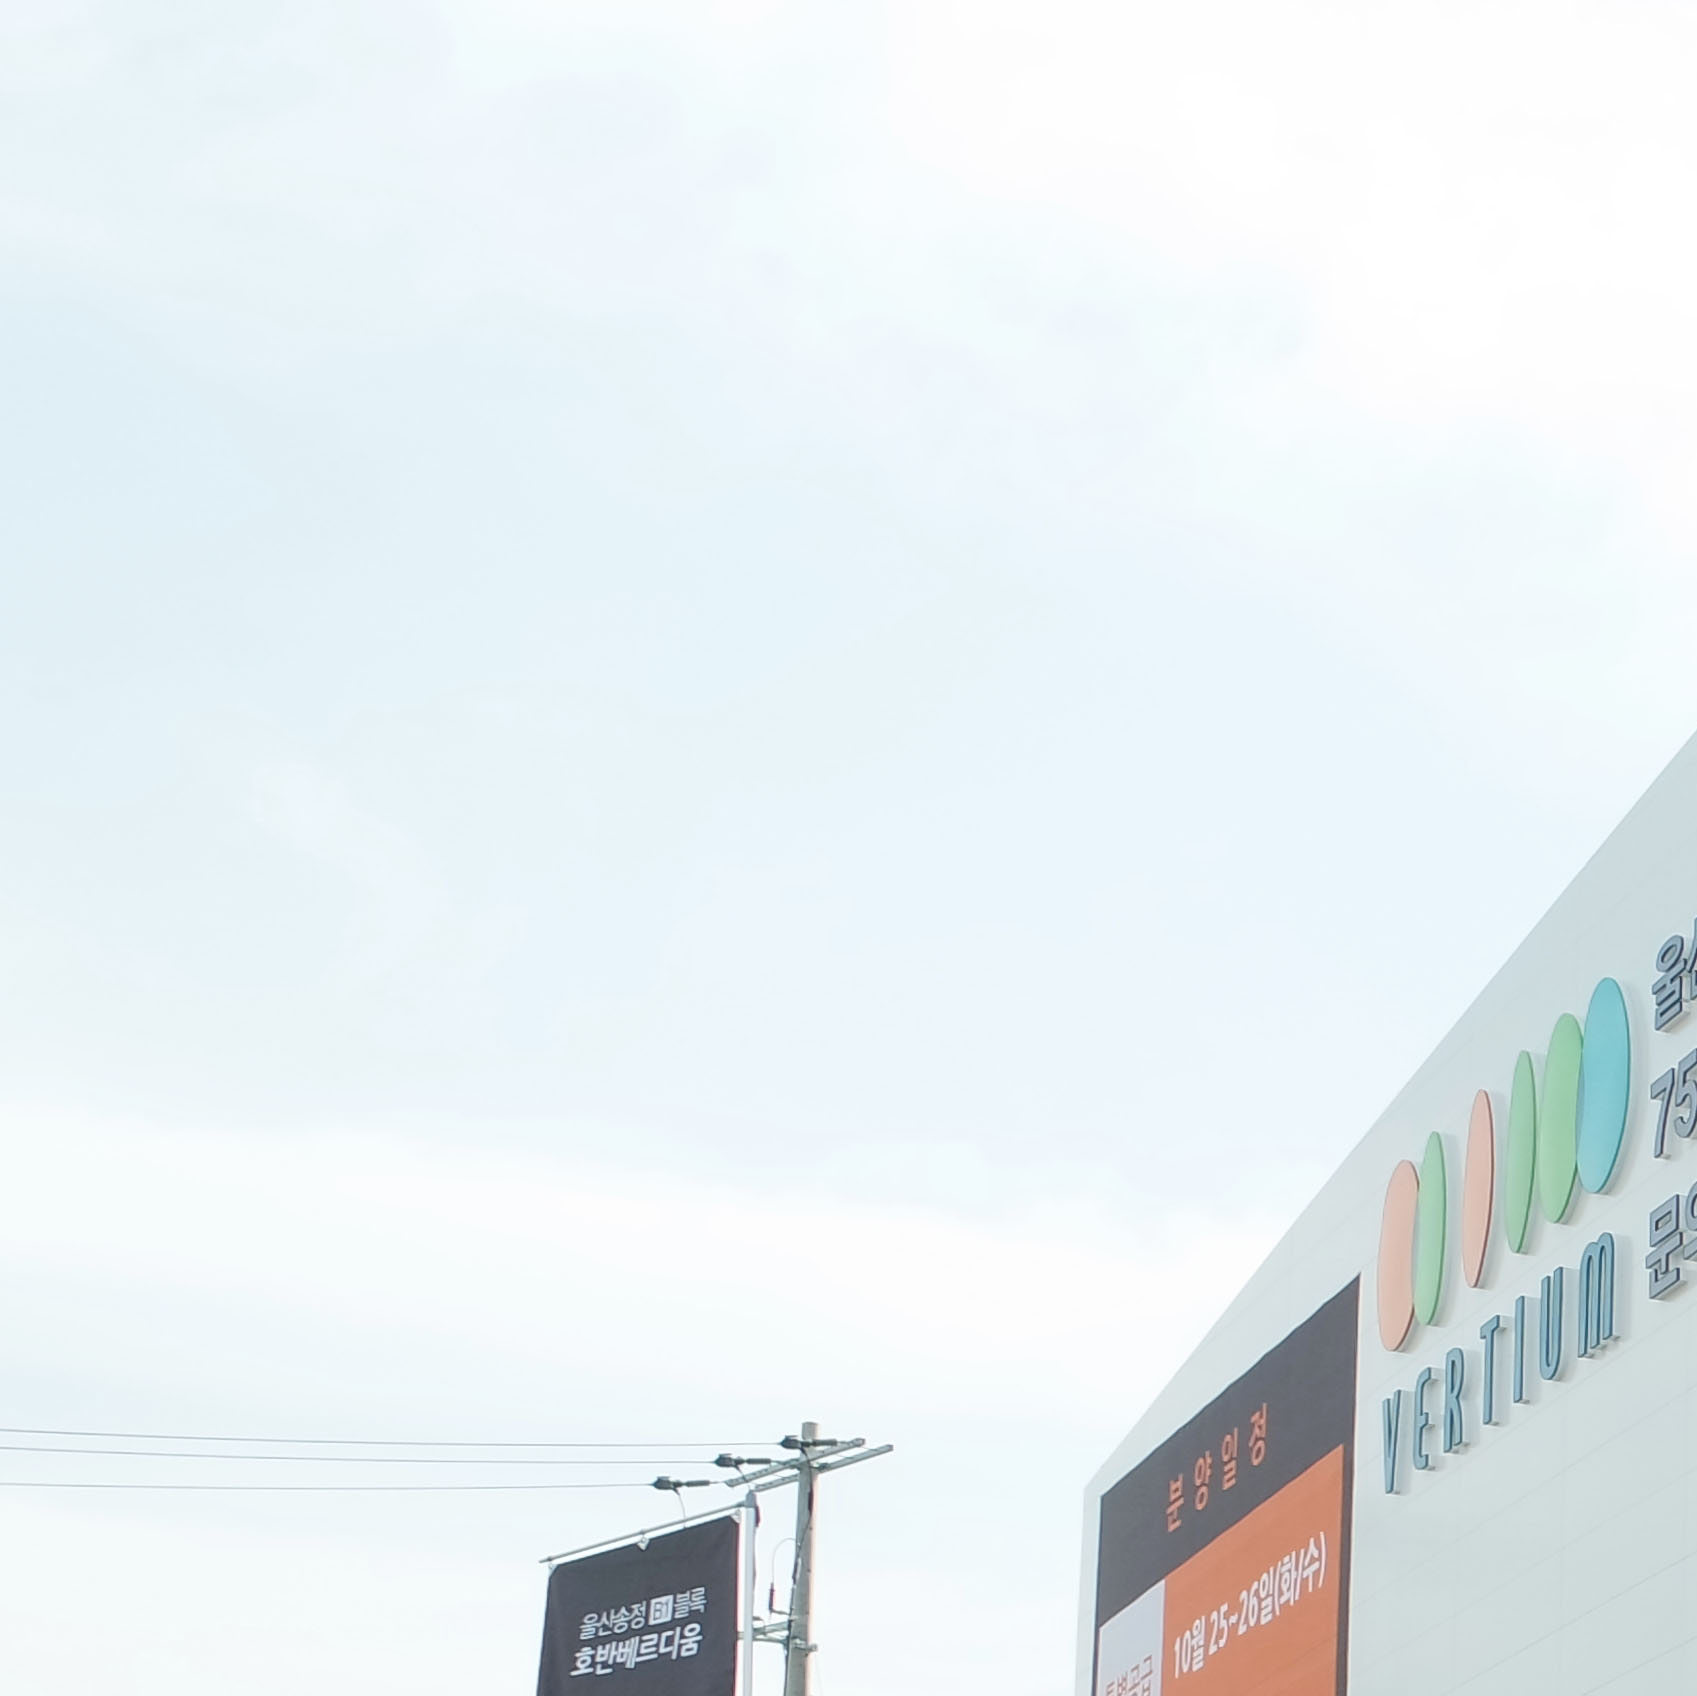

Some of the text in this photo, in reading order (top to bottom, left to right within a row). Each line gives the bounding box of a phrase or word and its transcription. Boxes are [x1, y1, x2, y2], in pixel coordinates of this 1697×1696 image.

[1382, 1231, 1616, 1495] VERTIUM
[578, 1600, 648, 1641] 울산송정
[673, 1586, 708, 1619] 블록
[569, 1622, 704, 1677] 호반베르디움
[1173, 1615, 1206, 1679] 10월
